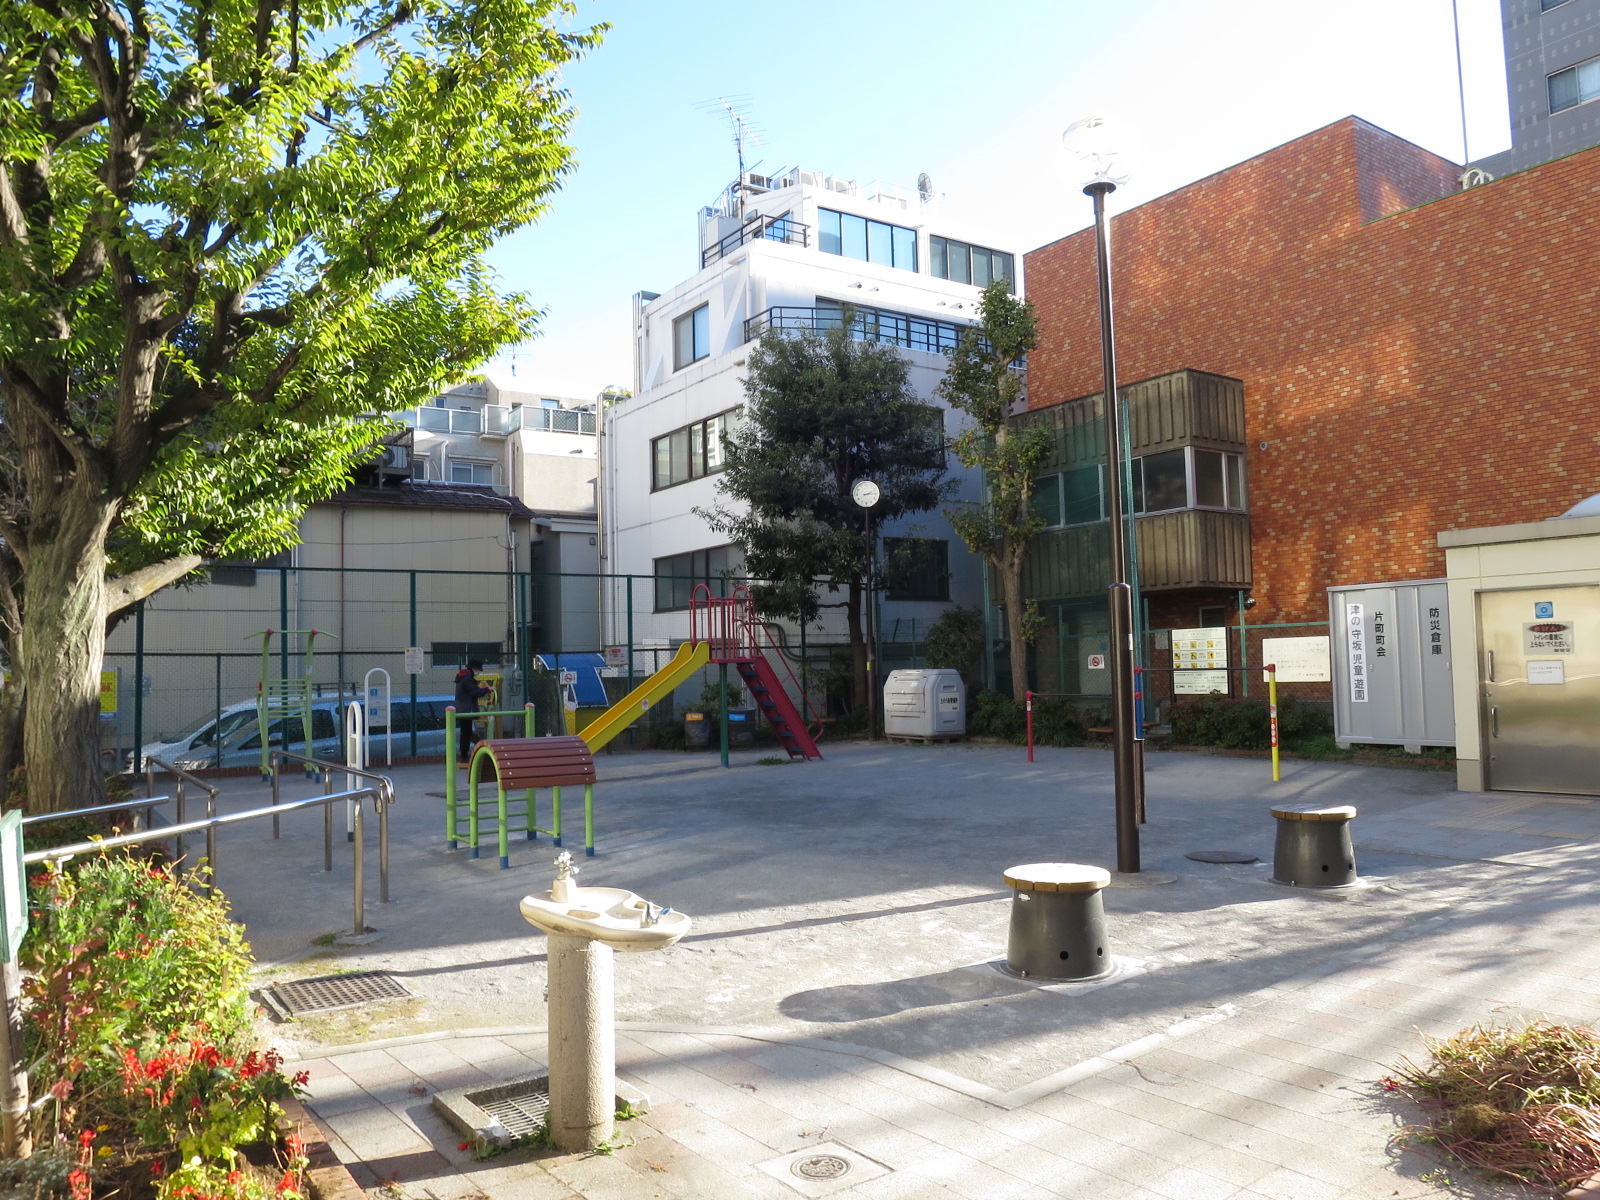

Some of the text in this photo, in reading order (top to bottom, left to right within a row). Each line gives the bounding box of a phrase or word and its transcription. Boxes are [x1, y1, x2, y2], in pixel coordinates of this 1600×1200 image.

[1350, 604, 1365, 701] 津の守坂児童遊園
[1374, 611, 1386, 657] 片町町会
[1429, 607, 1442, 655] 防災倉庫
